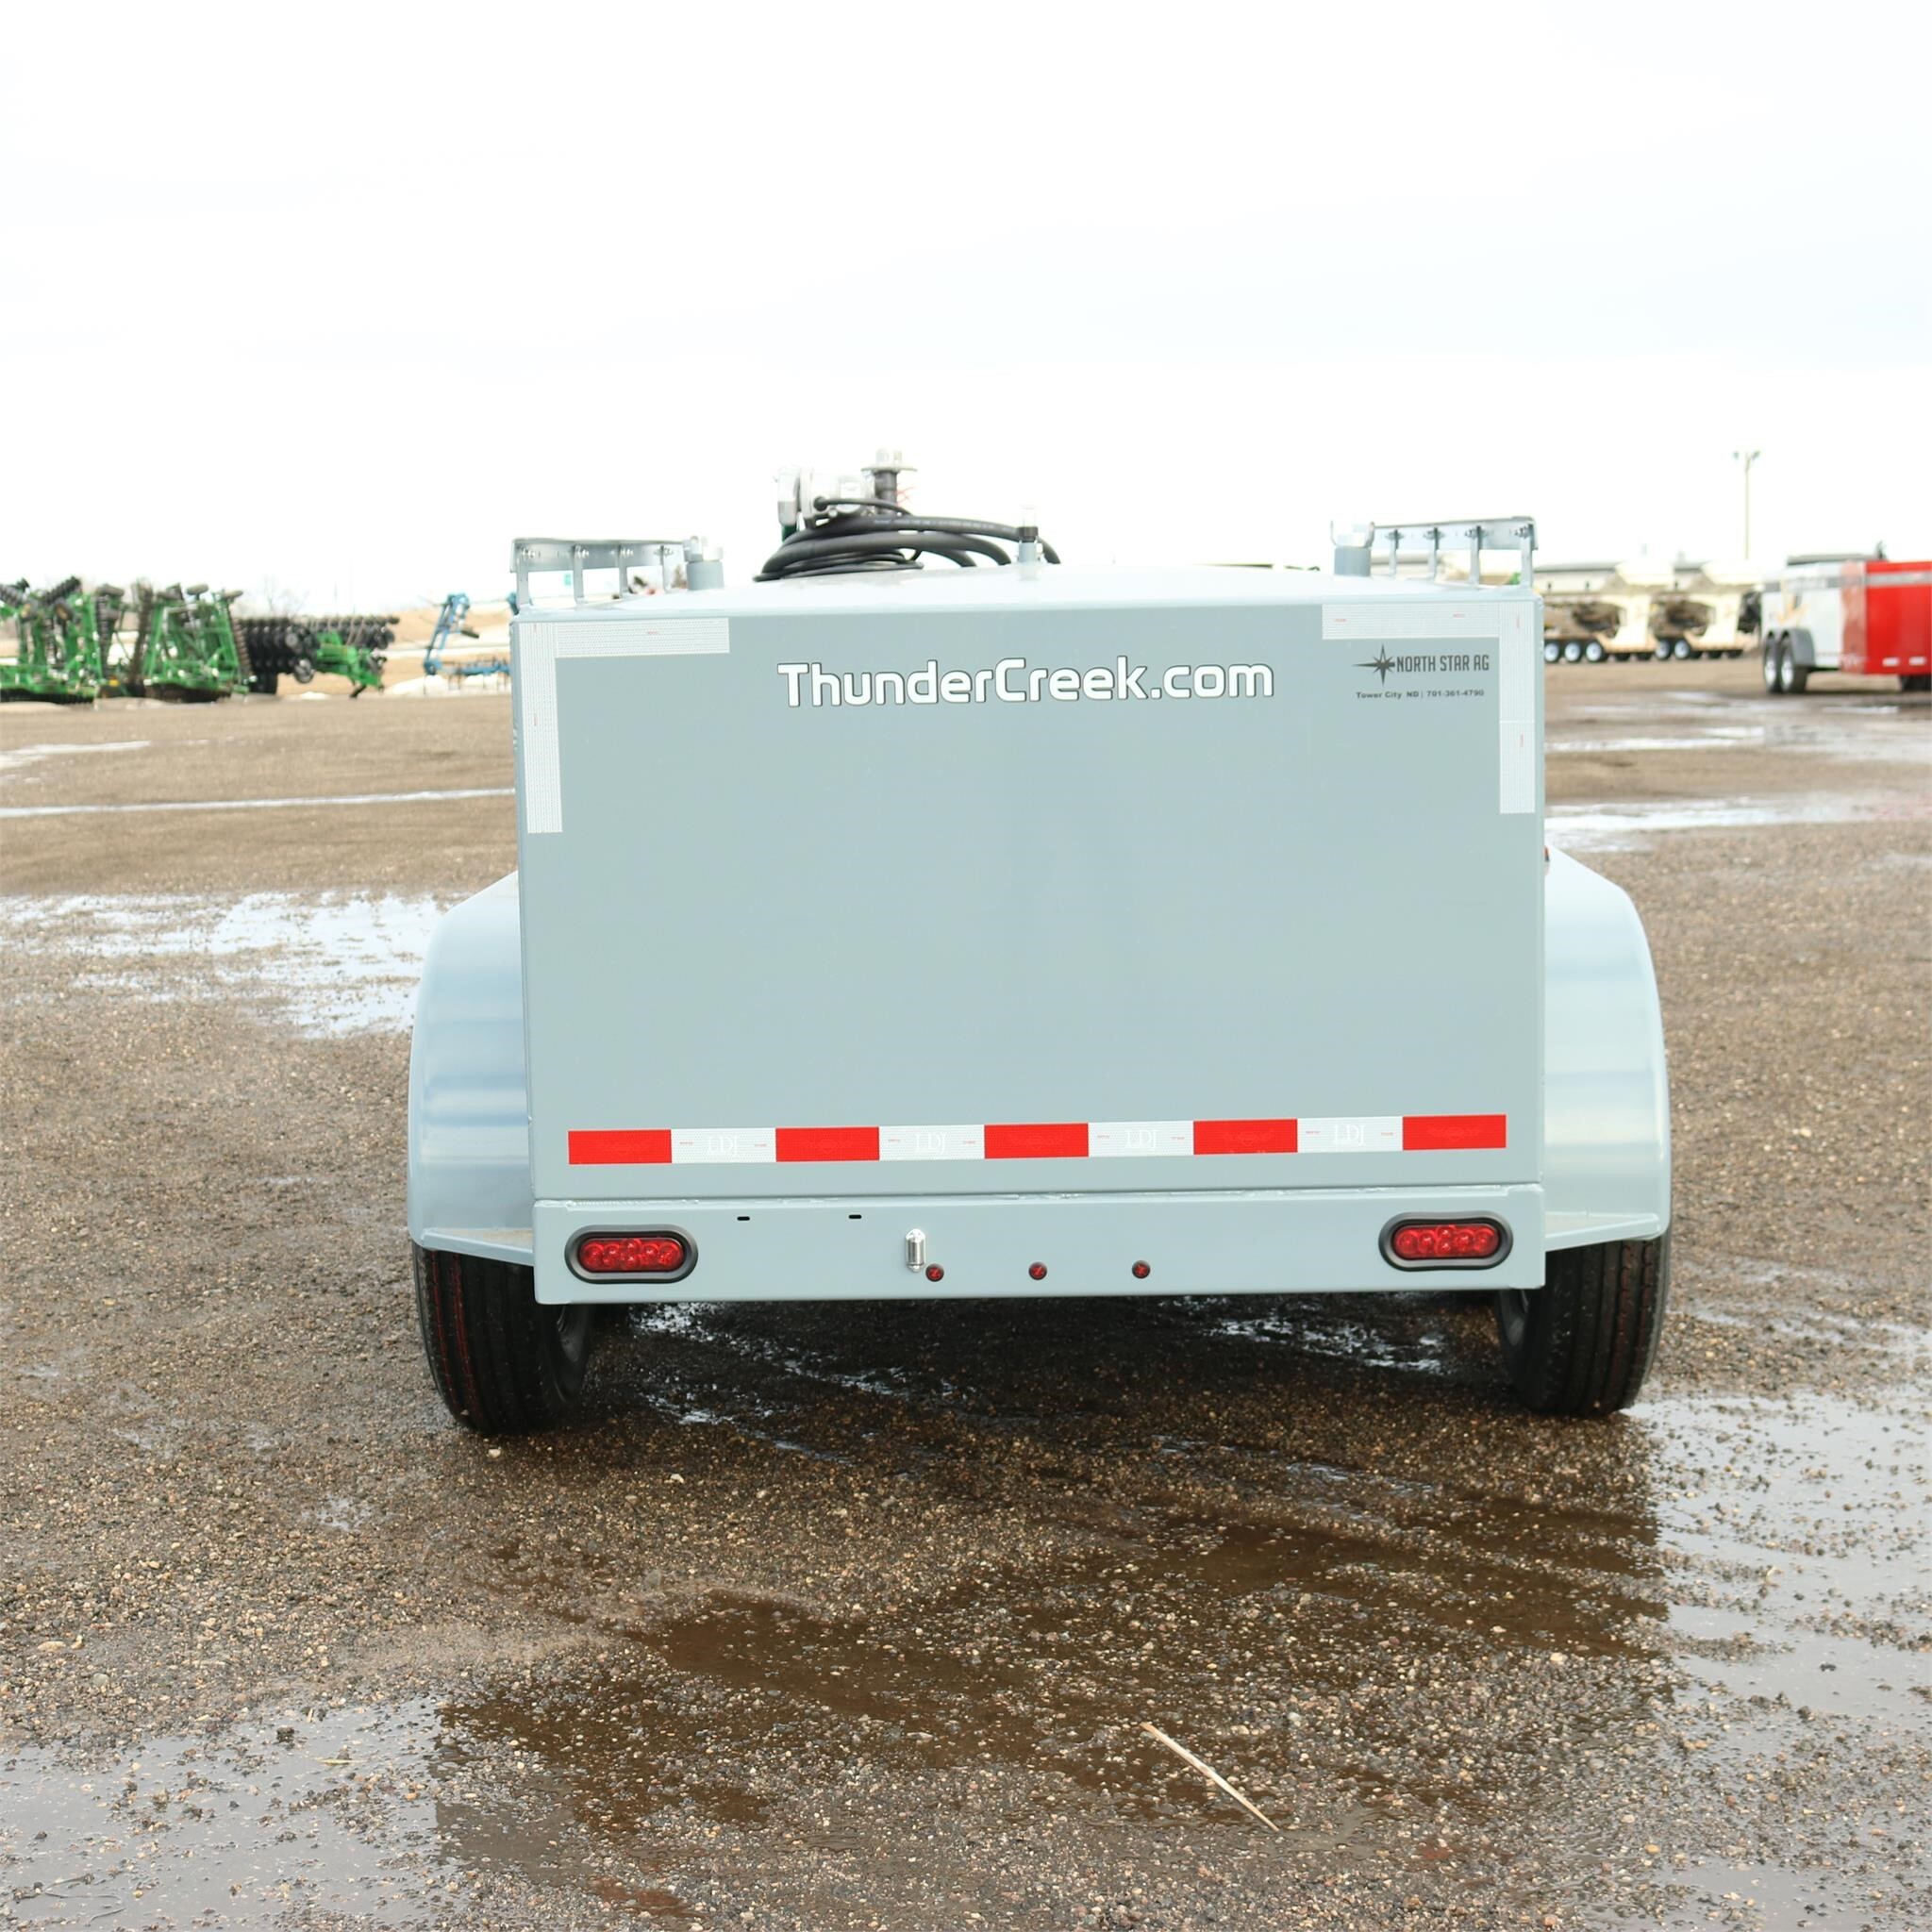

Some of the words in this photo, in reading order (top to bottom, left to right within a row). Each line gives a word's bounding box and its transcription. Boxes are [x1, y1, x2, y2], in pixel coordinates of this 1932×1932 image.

[1396, 655, 1436, 673] NORTH
[1440, 655, 1470, 672] STAR
[1473, 654, 1490, 671] AG
[776, 656, 1274, 708] ThunderCreek.com
[1356, 691, 1382, 699] Tower
[1384, 691, 1402, 700] City
[1406, 690, 1419, 698] ND
